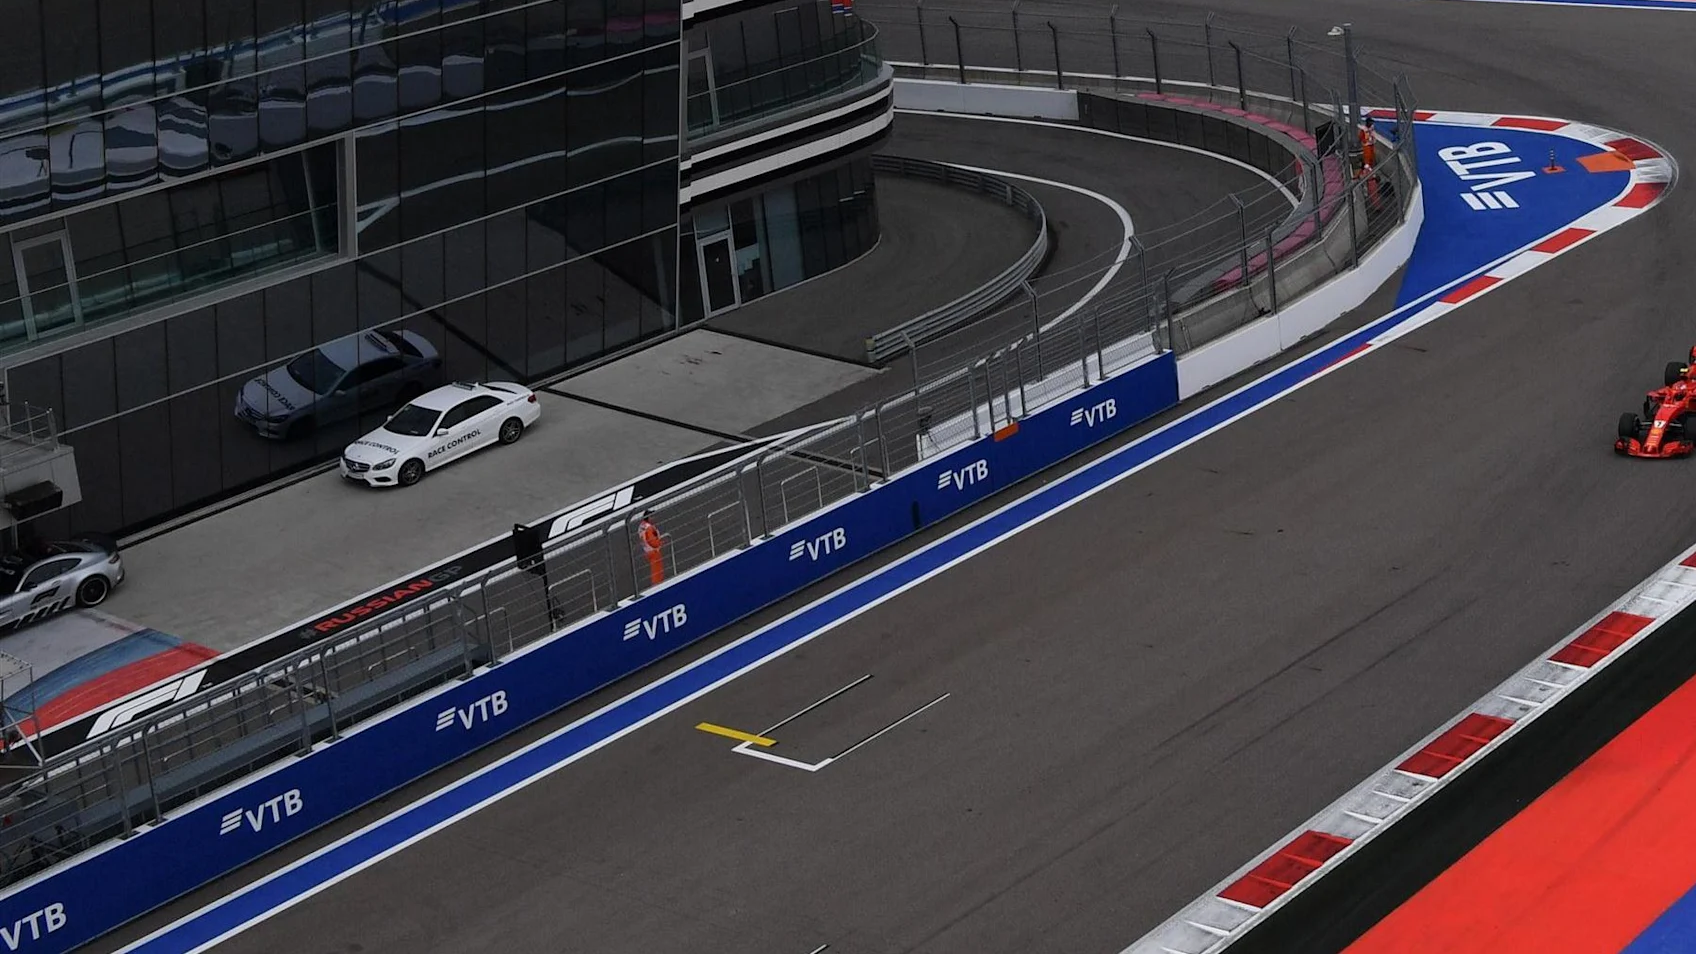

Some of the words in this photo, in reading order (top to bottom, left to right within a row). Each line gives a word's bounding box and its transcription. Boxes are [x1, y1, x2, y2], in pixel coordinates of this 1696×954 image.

[1438, 141, 1536, 192] VTB
[1084, 398, 1117, 427] VTB
[428, 446, 446, 458] RACE
[447, 429, 482, 450] CONTROL
[953, 459, 989, 491] VTB
[805, 527, 847, 562] VTB
[642, 603, 688, 641] VTB
[458, 689, 509, 732] VTB
[245, 789, 304, 833] VTB
[0, 902, 68, 951] VTB
